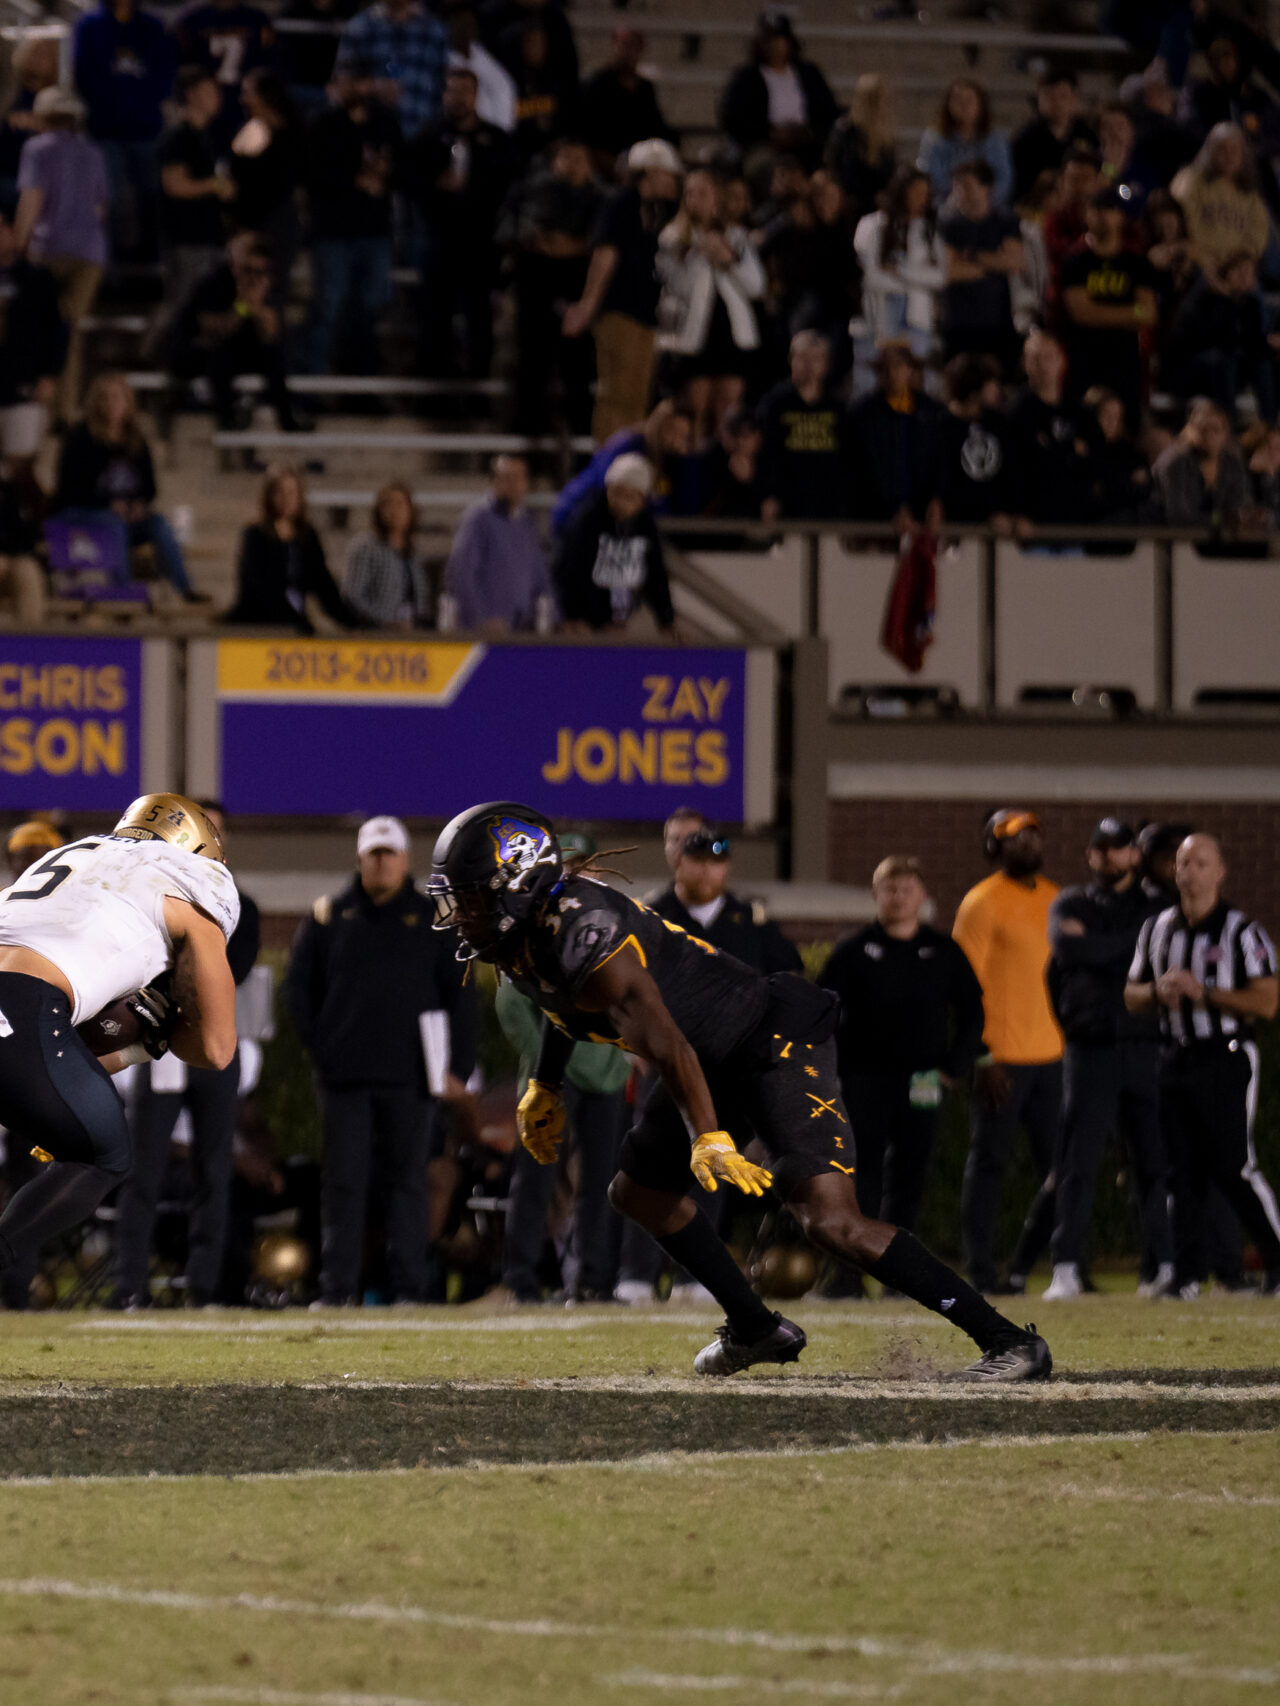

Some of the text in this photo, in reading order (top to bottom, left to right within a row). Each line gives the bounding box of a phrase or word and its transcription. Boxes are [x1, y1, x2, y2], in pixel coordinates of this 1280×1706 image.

[268, 650, 428, 683] 2013-2016
[641, 675, 729, 722] ZAY
[542, 727, 730, 786] JONES
[146, 805, 163, 822] 5
[6, 843, 101, 901] 5
